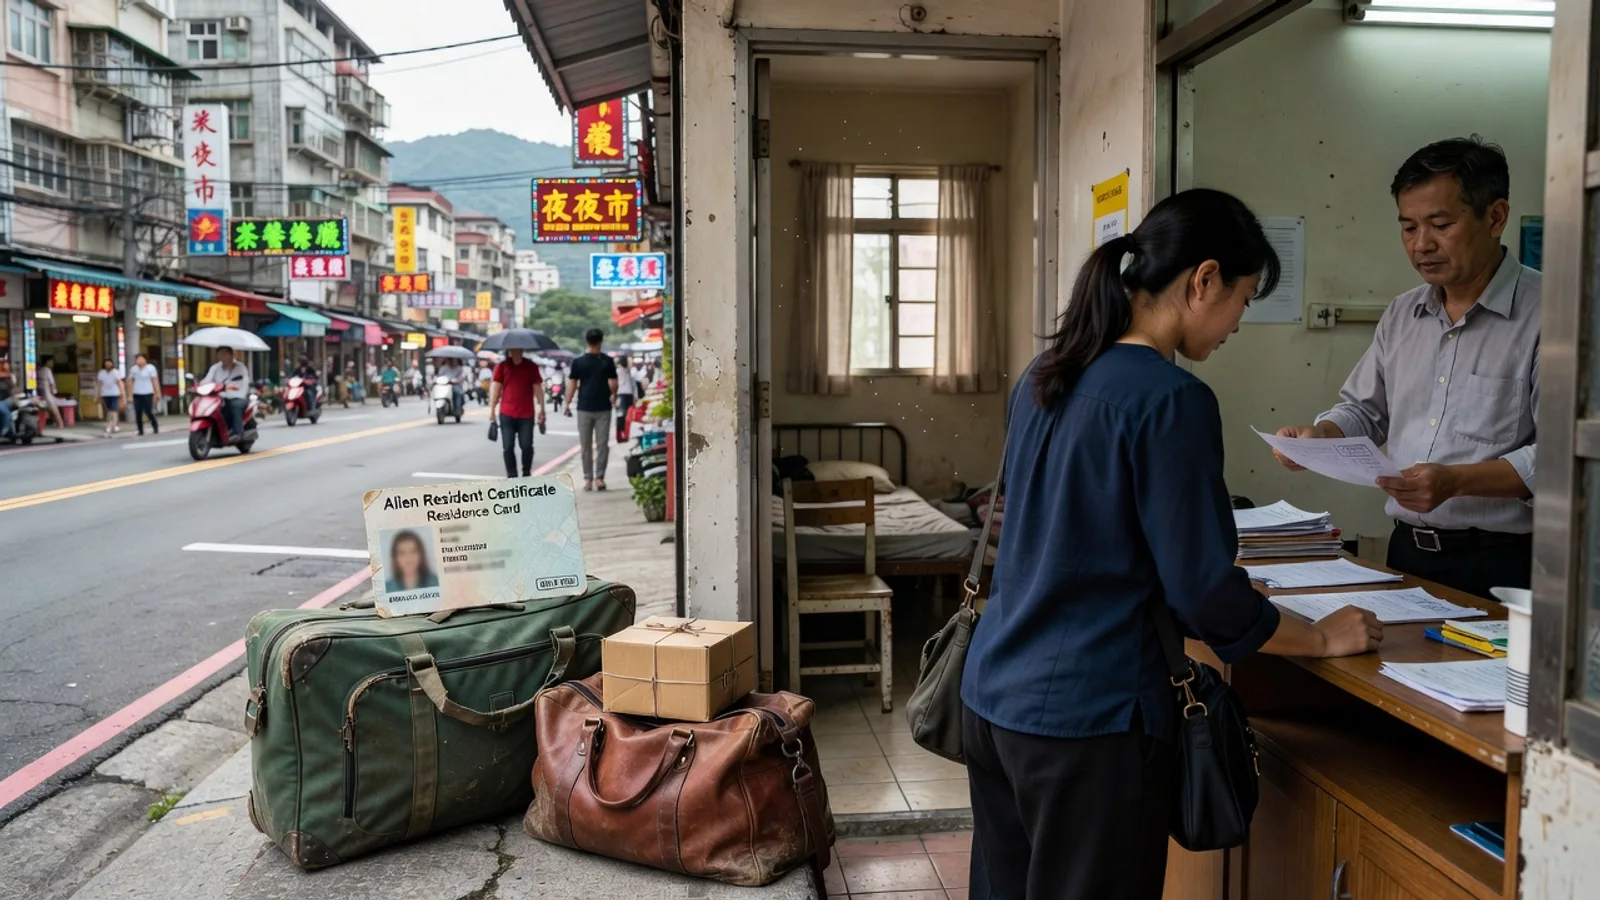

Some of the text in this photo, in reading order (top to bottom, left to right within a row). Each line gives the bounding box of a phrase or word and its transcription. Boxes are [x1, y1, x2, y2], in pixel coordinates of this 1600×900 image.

[541, 188, 634, 223] 夜夜市
[423, 489, 484, 507] Resident
[487, 484, 557, 500] Certificate
[427, 502, 521, 522] Residence Card
